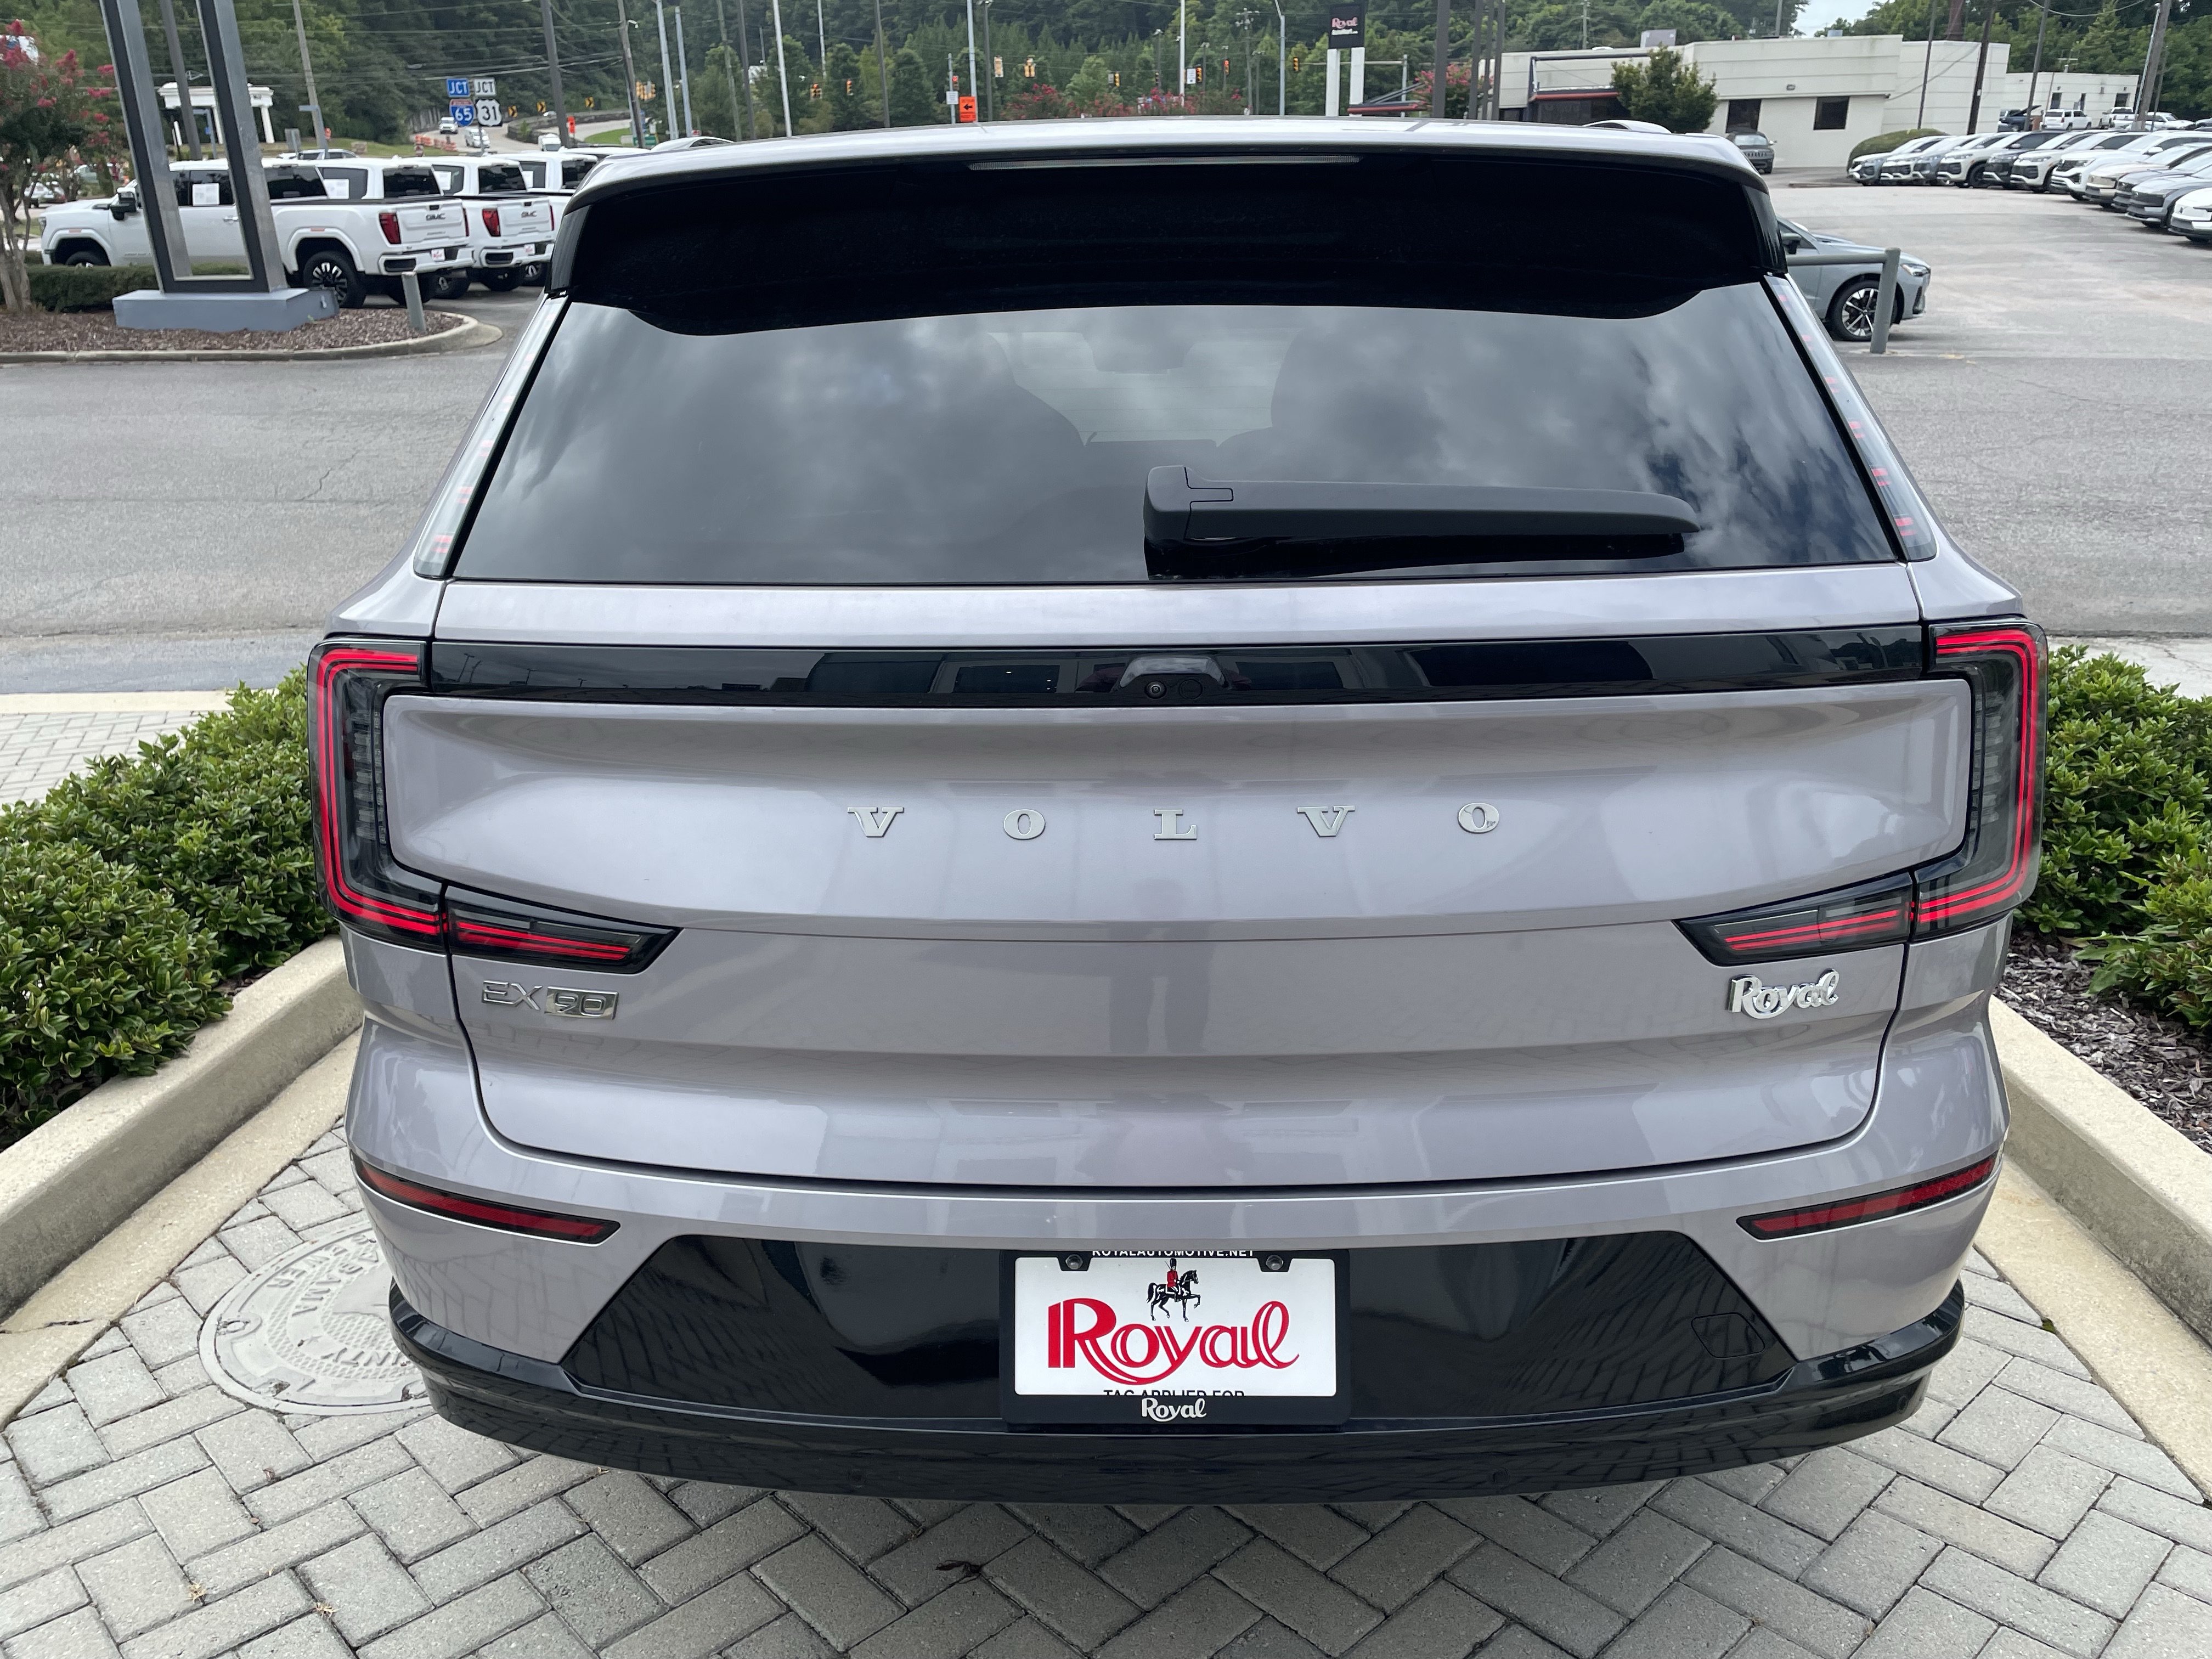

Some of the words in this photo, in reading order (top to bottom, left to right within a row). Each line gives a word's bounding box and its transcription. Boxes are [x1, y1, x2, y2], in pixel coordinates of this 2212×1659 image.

[1331, 17, 1358, 29] Royal
[449, 81, 467, 94] JCT
[476, 81, 494, 93] JCT
[455, 108, 472, 121] 65
[481, 106, 497, 120] 31
[847, 802, 1500, 841] VOLVO
[482, 980, 619, 1020] EX90
[1726, 968, 1839, 1019] Royal
[1048, 1298, 1300, 1385] Royal
[1142, 1397, 1207, 1422] Royal
